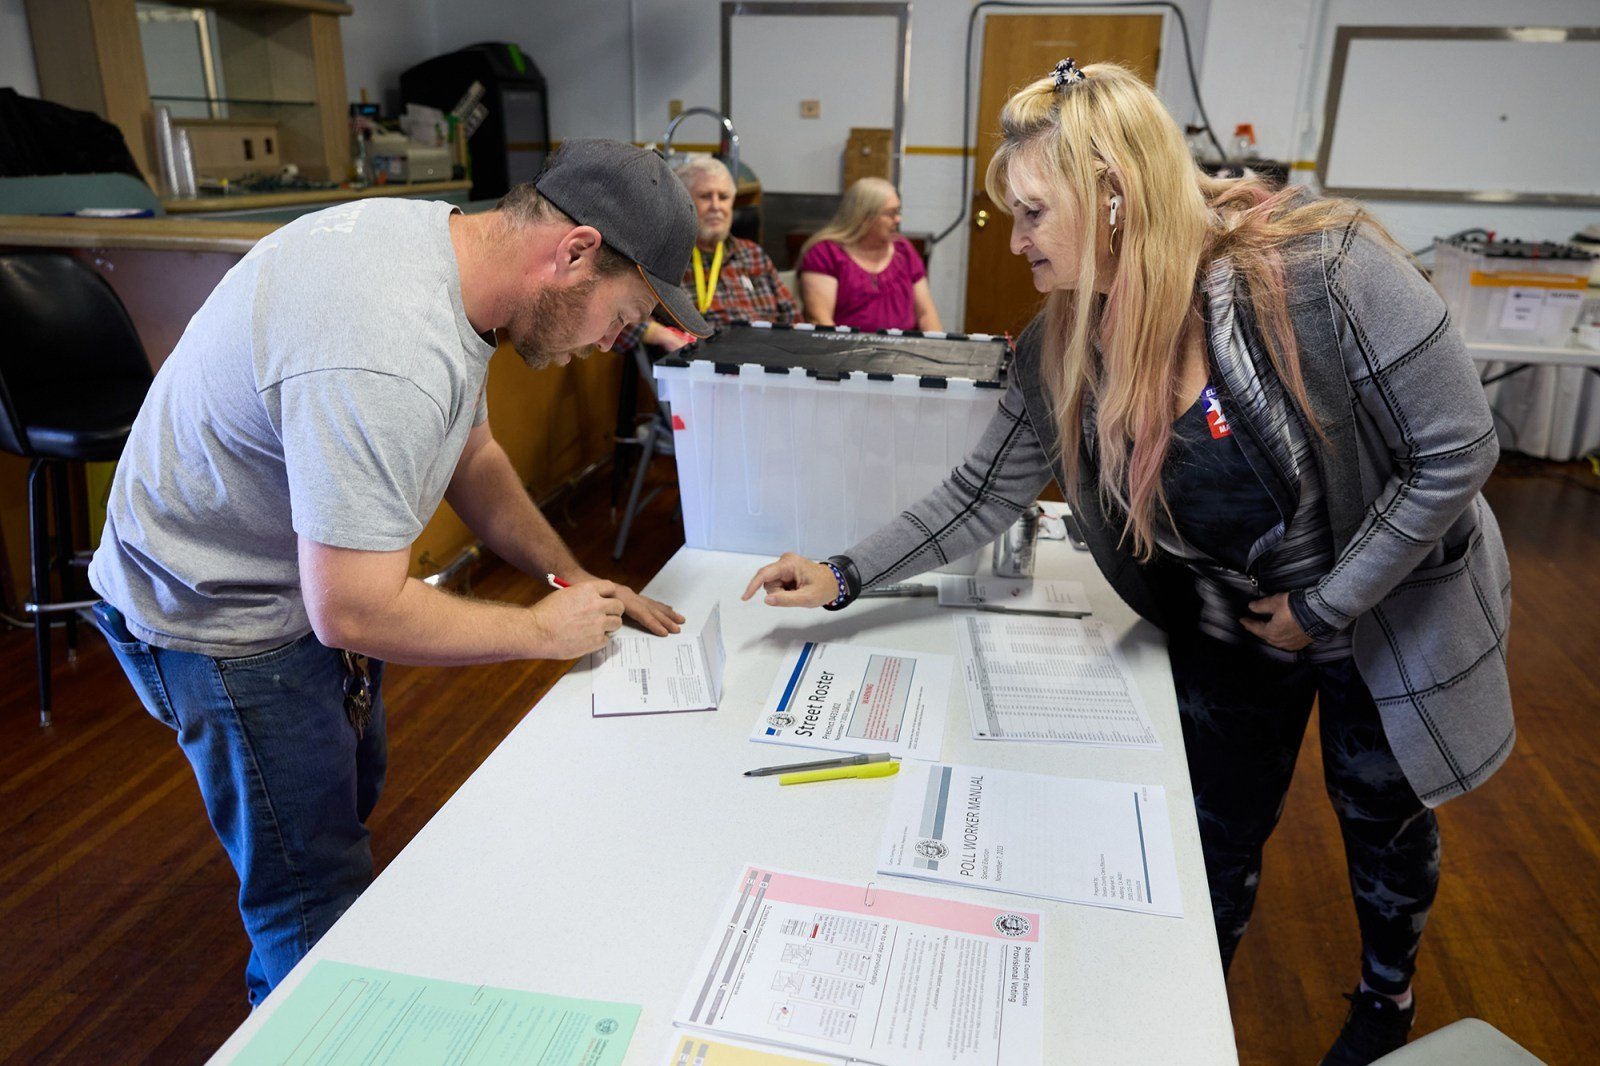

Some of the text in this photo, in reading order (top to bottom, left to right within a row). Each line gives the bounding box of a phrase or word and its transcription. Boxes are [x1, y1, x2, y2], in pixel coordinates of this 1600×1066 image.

[795, 671, 834, 736] Street Roster
[862, 684, 874, 704] WARNING
[822, 721, 834, 739] Precinct
[960, 776, 983, 876] POLL WORKER MANUAL
[980, 848, 989, 879] Special Election
[869, 953, 882, 985] provisionally
[1008, 946, 1021, 1003] Provisional Voting
[1021, 964, 1030, 981] County
